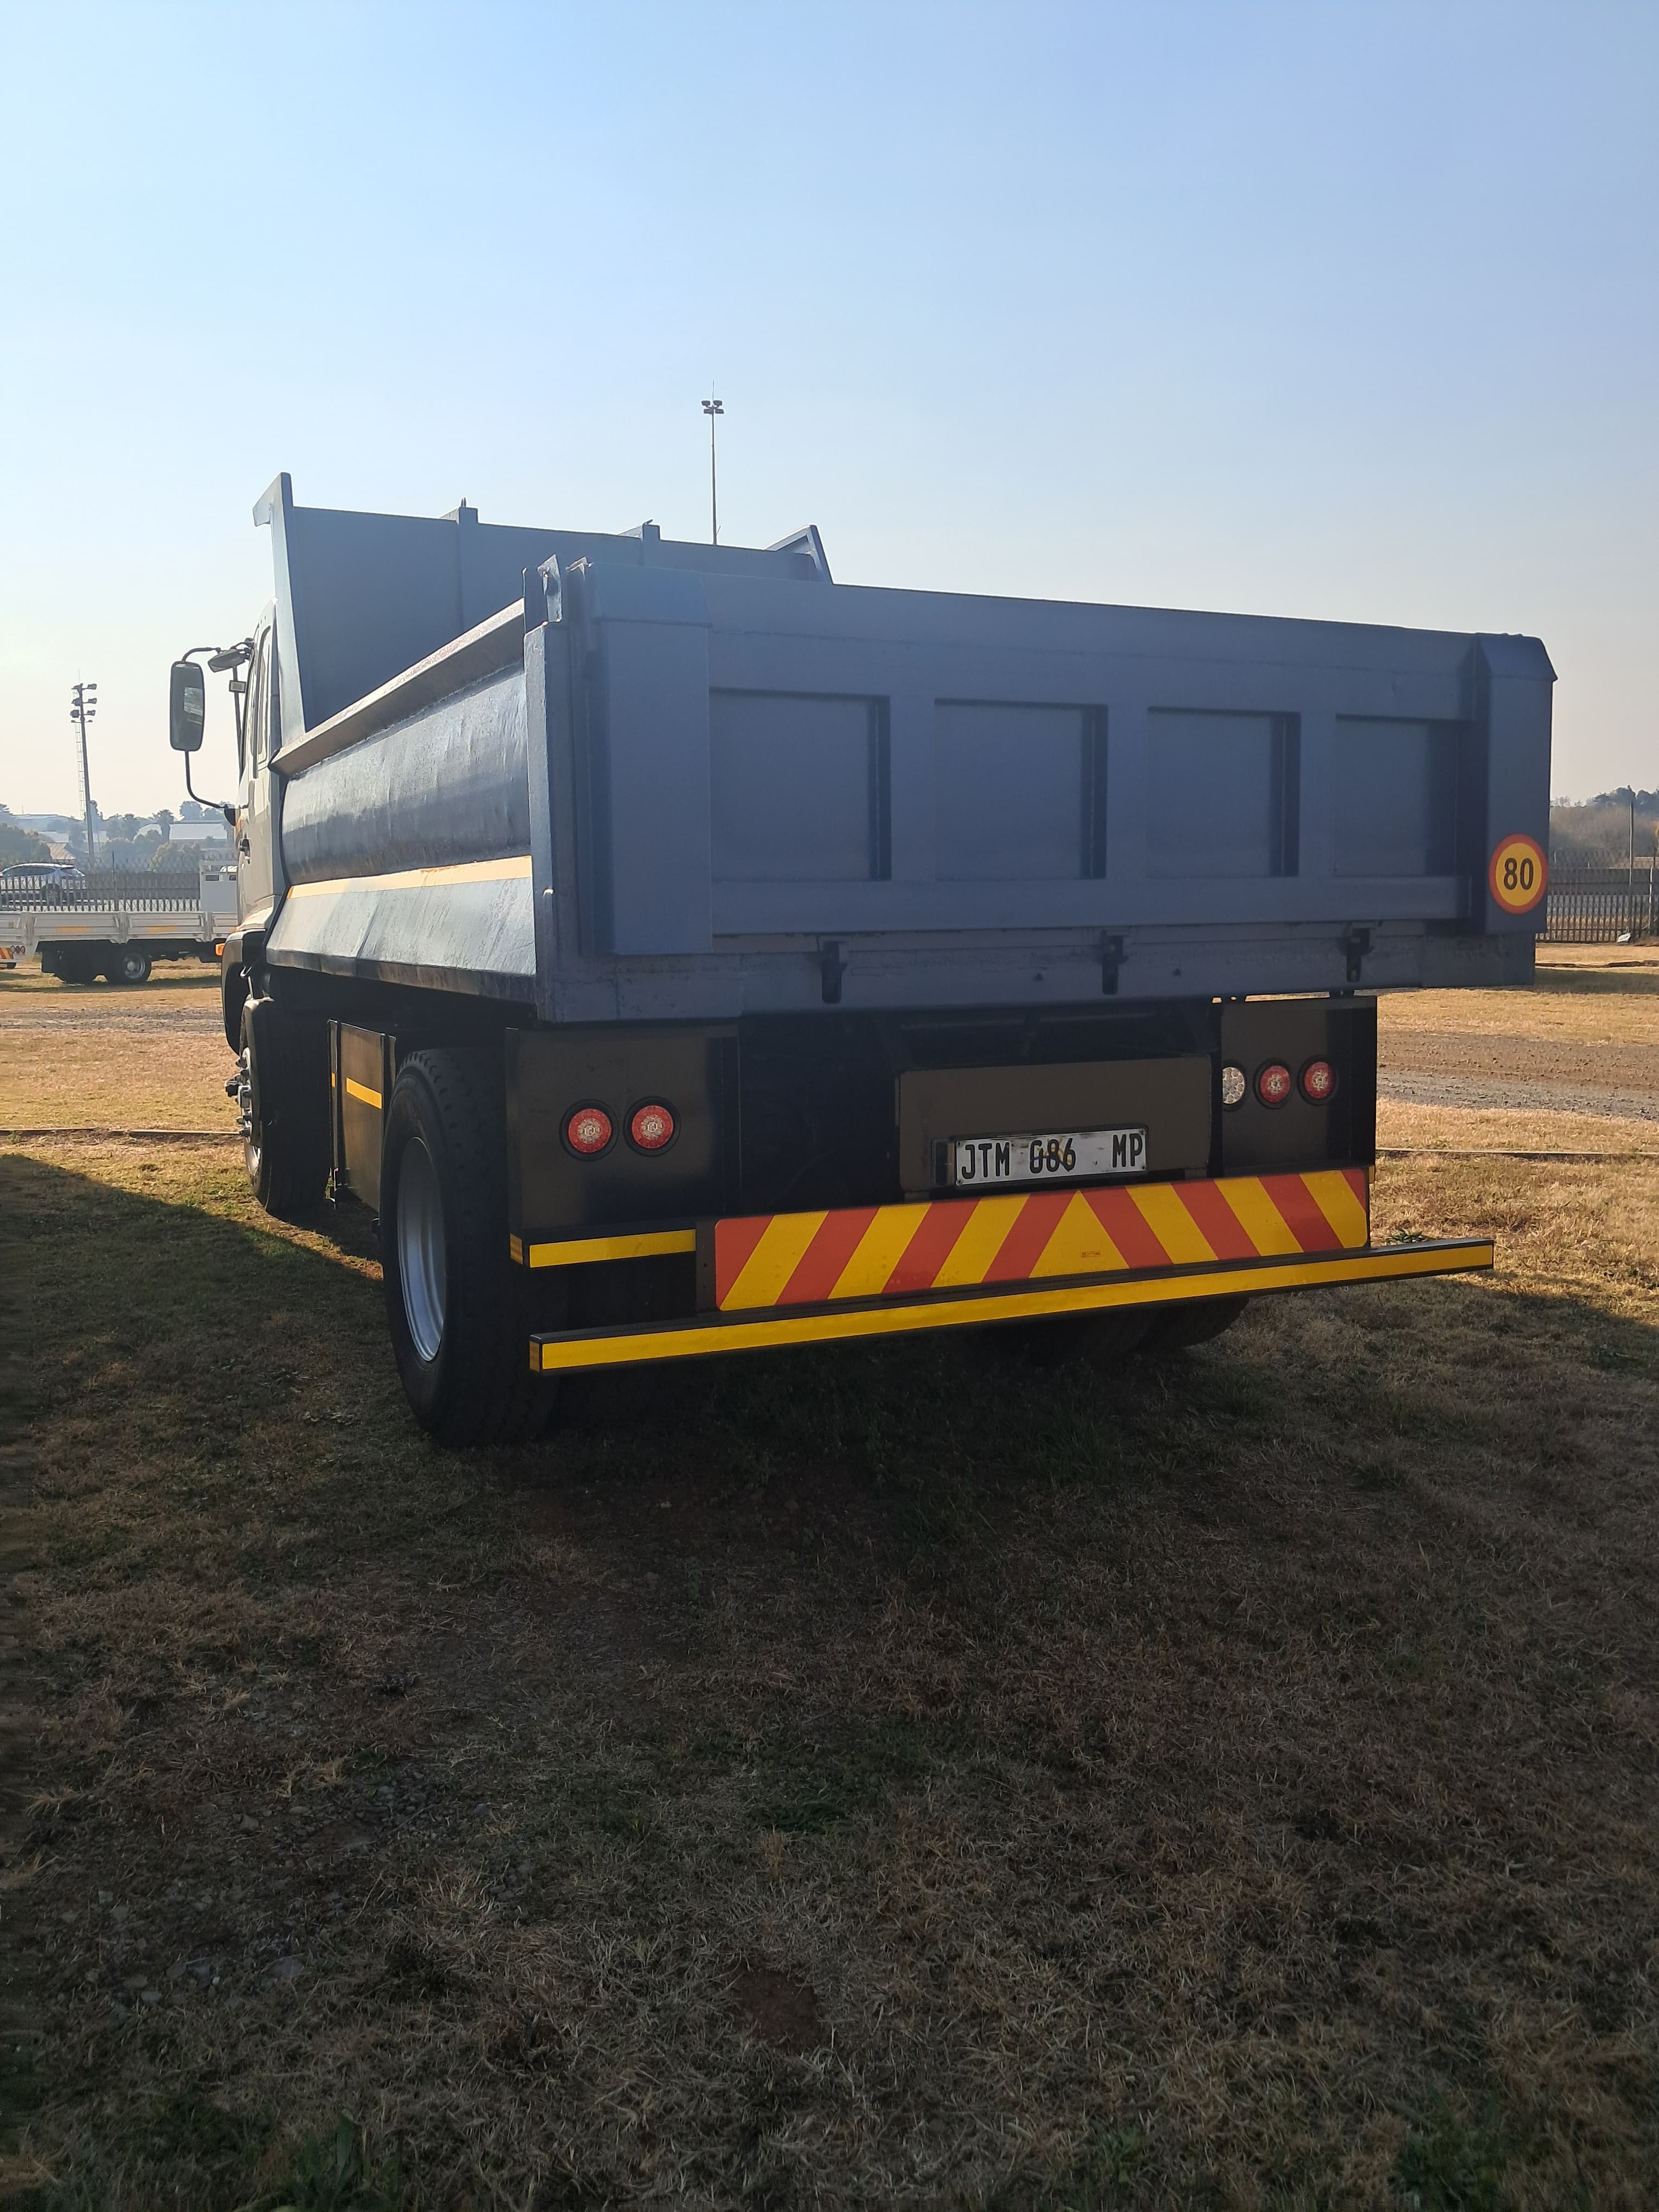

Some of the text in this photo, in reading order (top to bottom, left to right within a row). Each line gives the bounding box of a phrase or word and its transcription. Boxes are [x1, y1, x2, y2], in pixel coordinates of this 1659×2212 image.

[1503, 857, 1534, 890] 80
[961, 1133, 1143, 1180] JTM 086 MP
